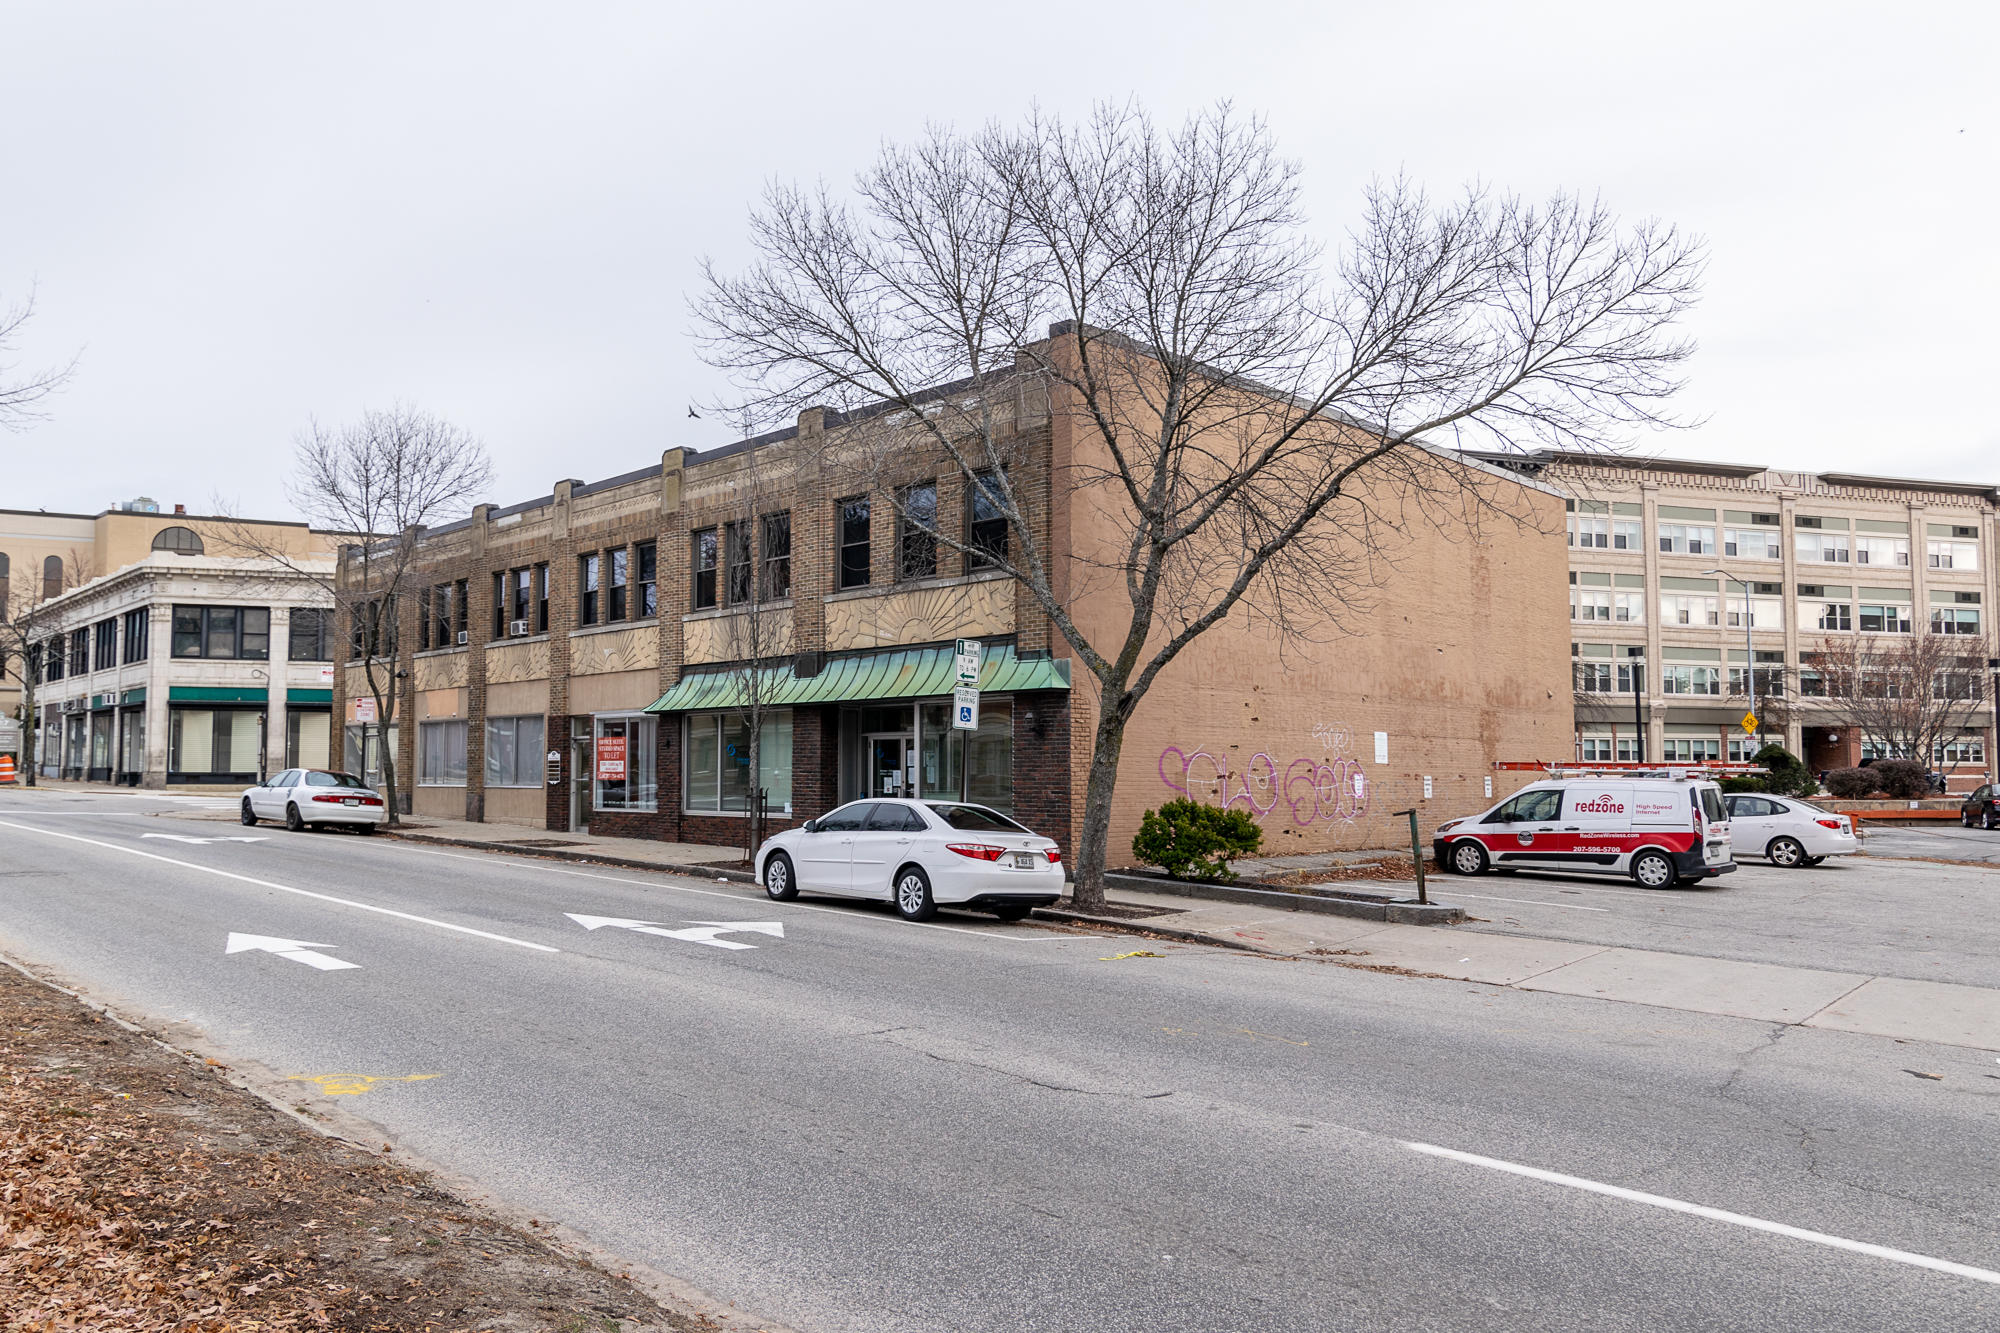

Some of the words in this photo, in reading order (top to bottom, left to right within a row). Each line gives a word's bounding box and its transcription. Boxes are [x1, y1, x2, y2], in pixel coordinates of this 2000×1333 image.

[957, 689, 977, 698] RESERVED
[958, 696, 976, 705] PARKING
[1575, 799, 1624, 813] redzone
